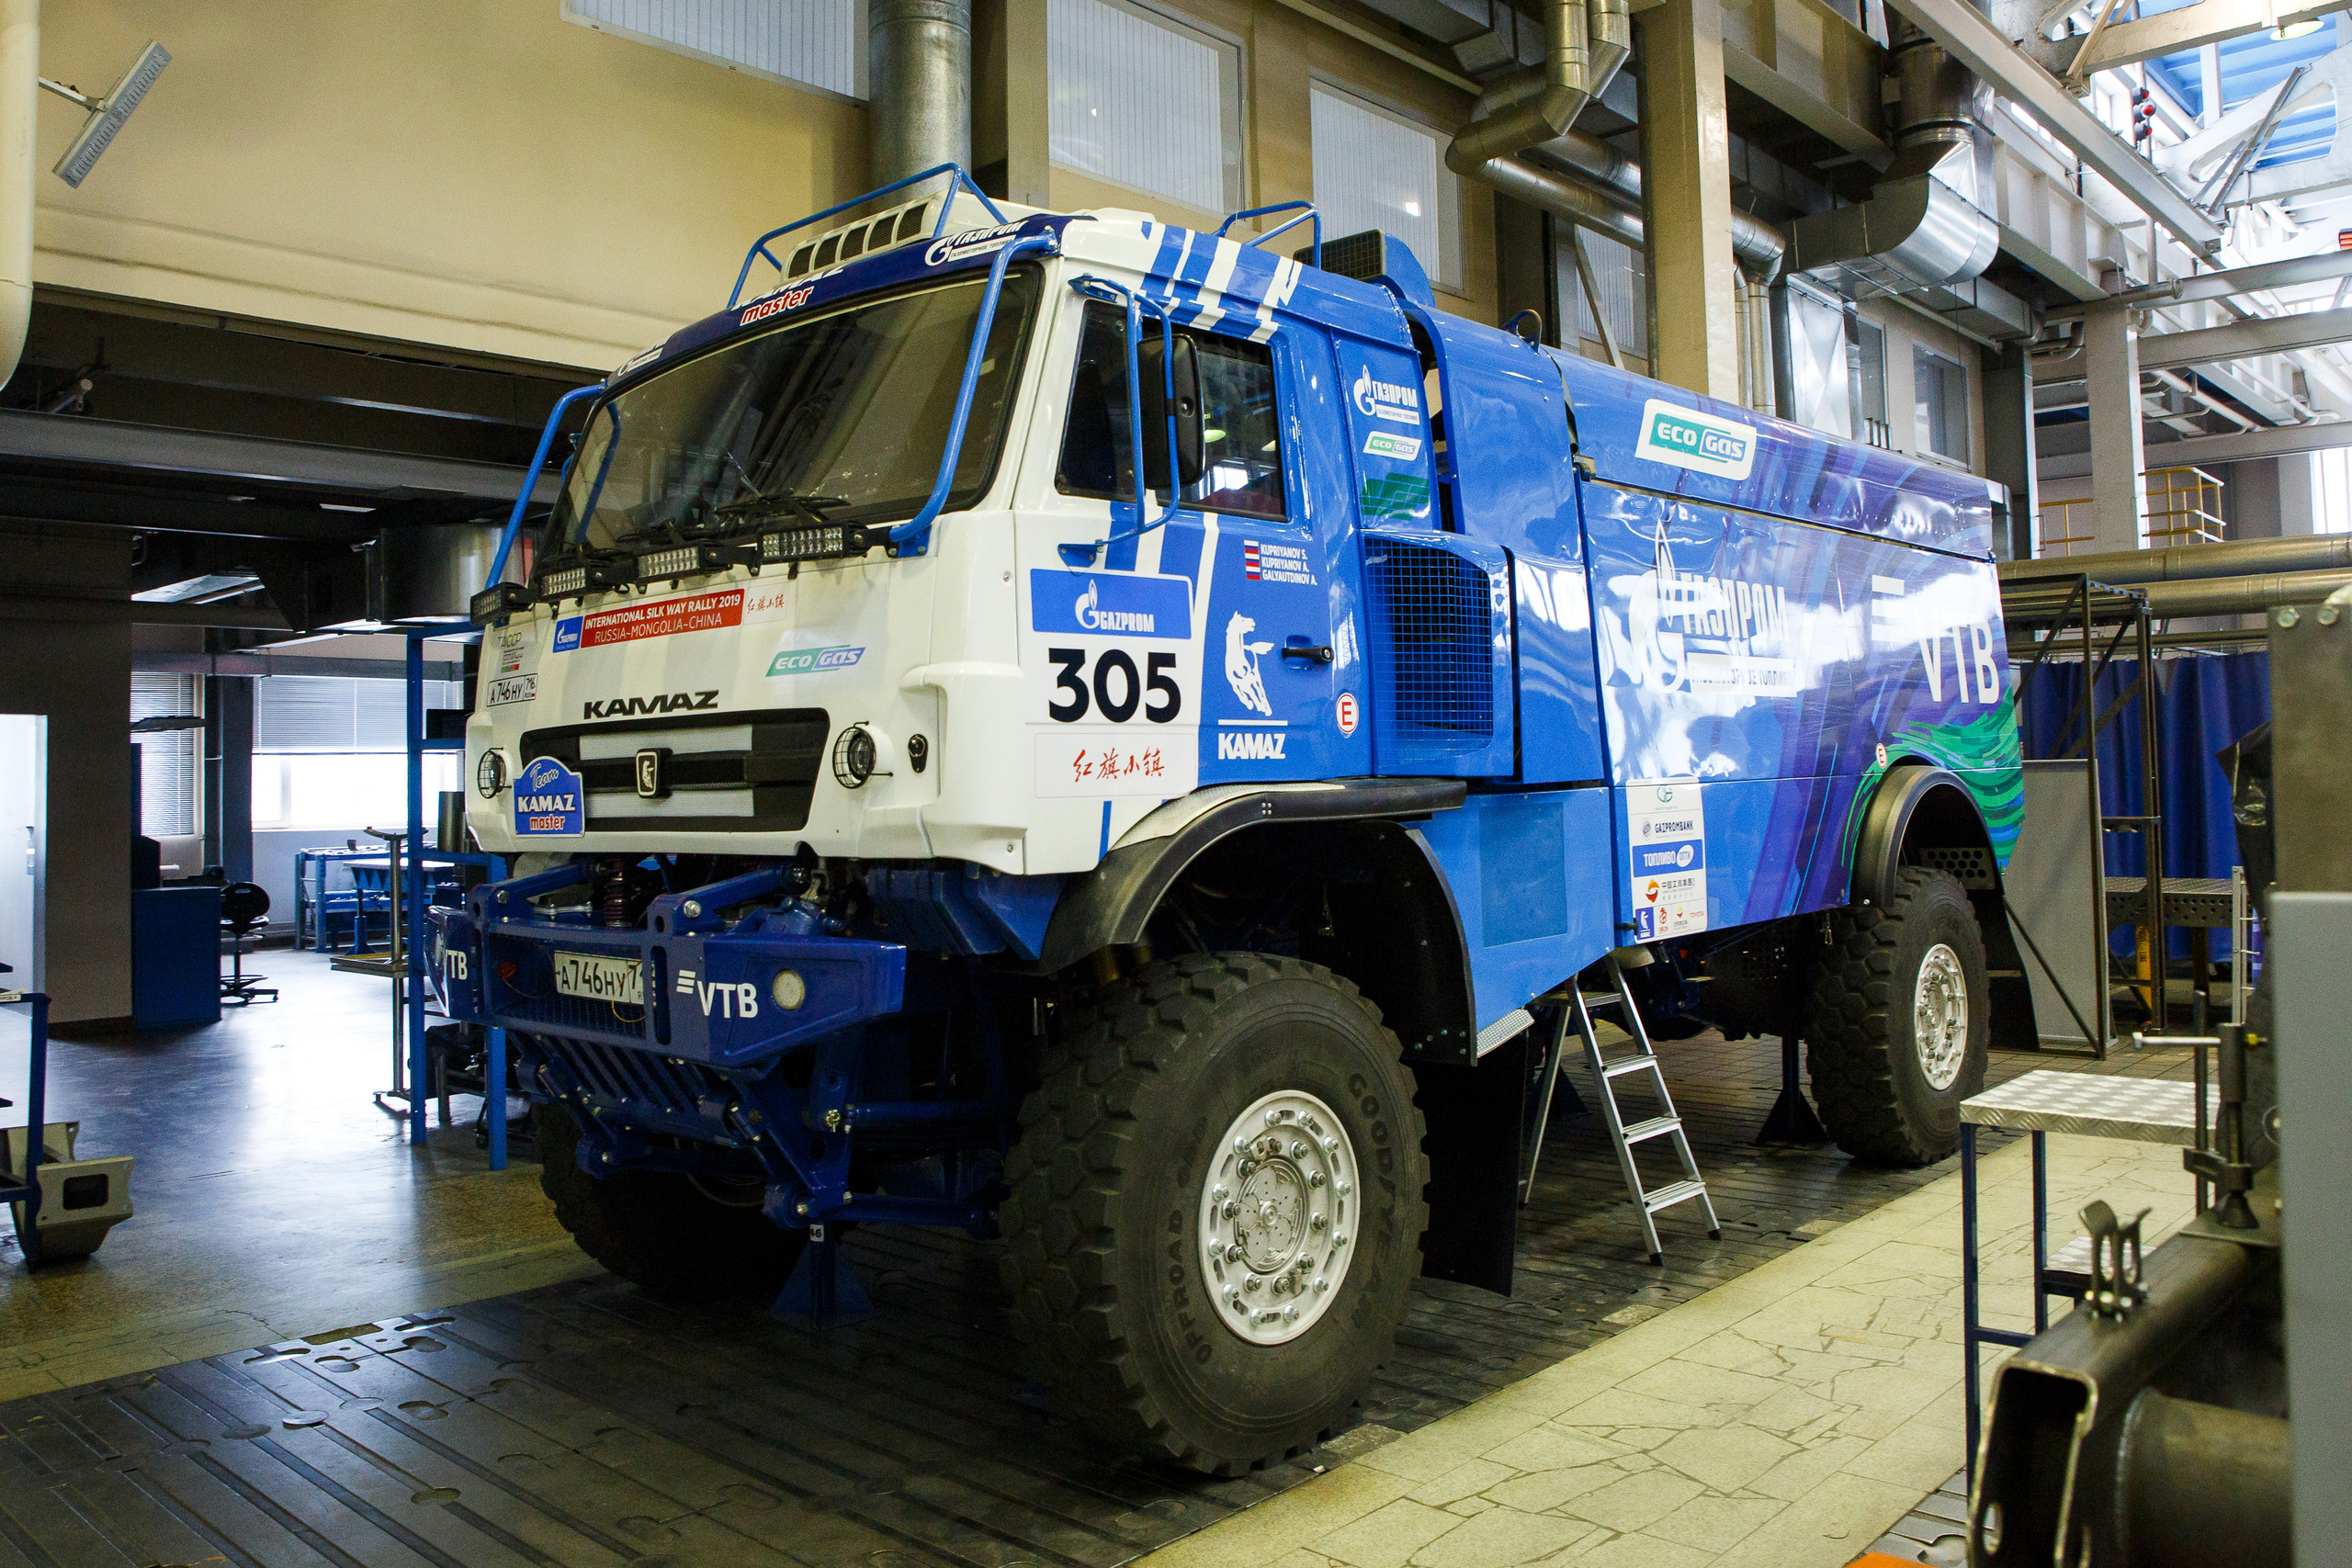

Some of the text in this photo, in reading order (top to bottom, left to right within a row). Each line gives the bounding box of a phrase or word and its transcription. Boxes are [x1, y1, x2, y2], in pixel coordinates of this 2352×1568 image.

[740, 286, 815, 326] master
[1373, 380, 1418, 408] ГАЗПРОМ
[1373, 438, 1393, 450] ECO
[1657, 422, 1698, 446] ECO
[1261, 544, 1308, 560] KUPRIYANOV S.
[1261, 557, 1310, 572] KUPRIYANOV A.
[1262, 569, 1318, 586] GALYAUTDINOV A.
[585, 594, 741, 629] INTERNATIONAL SILK WAY RALLY 2019
[1100, 610, 1155, 633] GAZPROM
[775, 655, 812, 670] ECO
[1048, 647, 1182, 723] 305
[583, 690, 718, 719] KAMAZ
[1342, 702, 1352, 726] E
[1217, 733, 1286, 761] KAMAZ
[530, 763, 559, 792] Team
[517, 794, 576, 813] KAMAZ
[529, 814, 565, 830] master
[1655, 820, 1694, 833] GAZPROMBANK
[1643, 851, 1676, 867] ТОПЛИВО
[696, 981, 759, 1019] VTB
